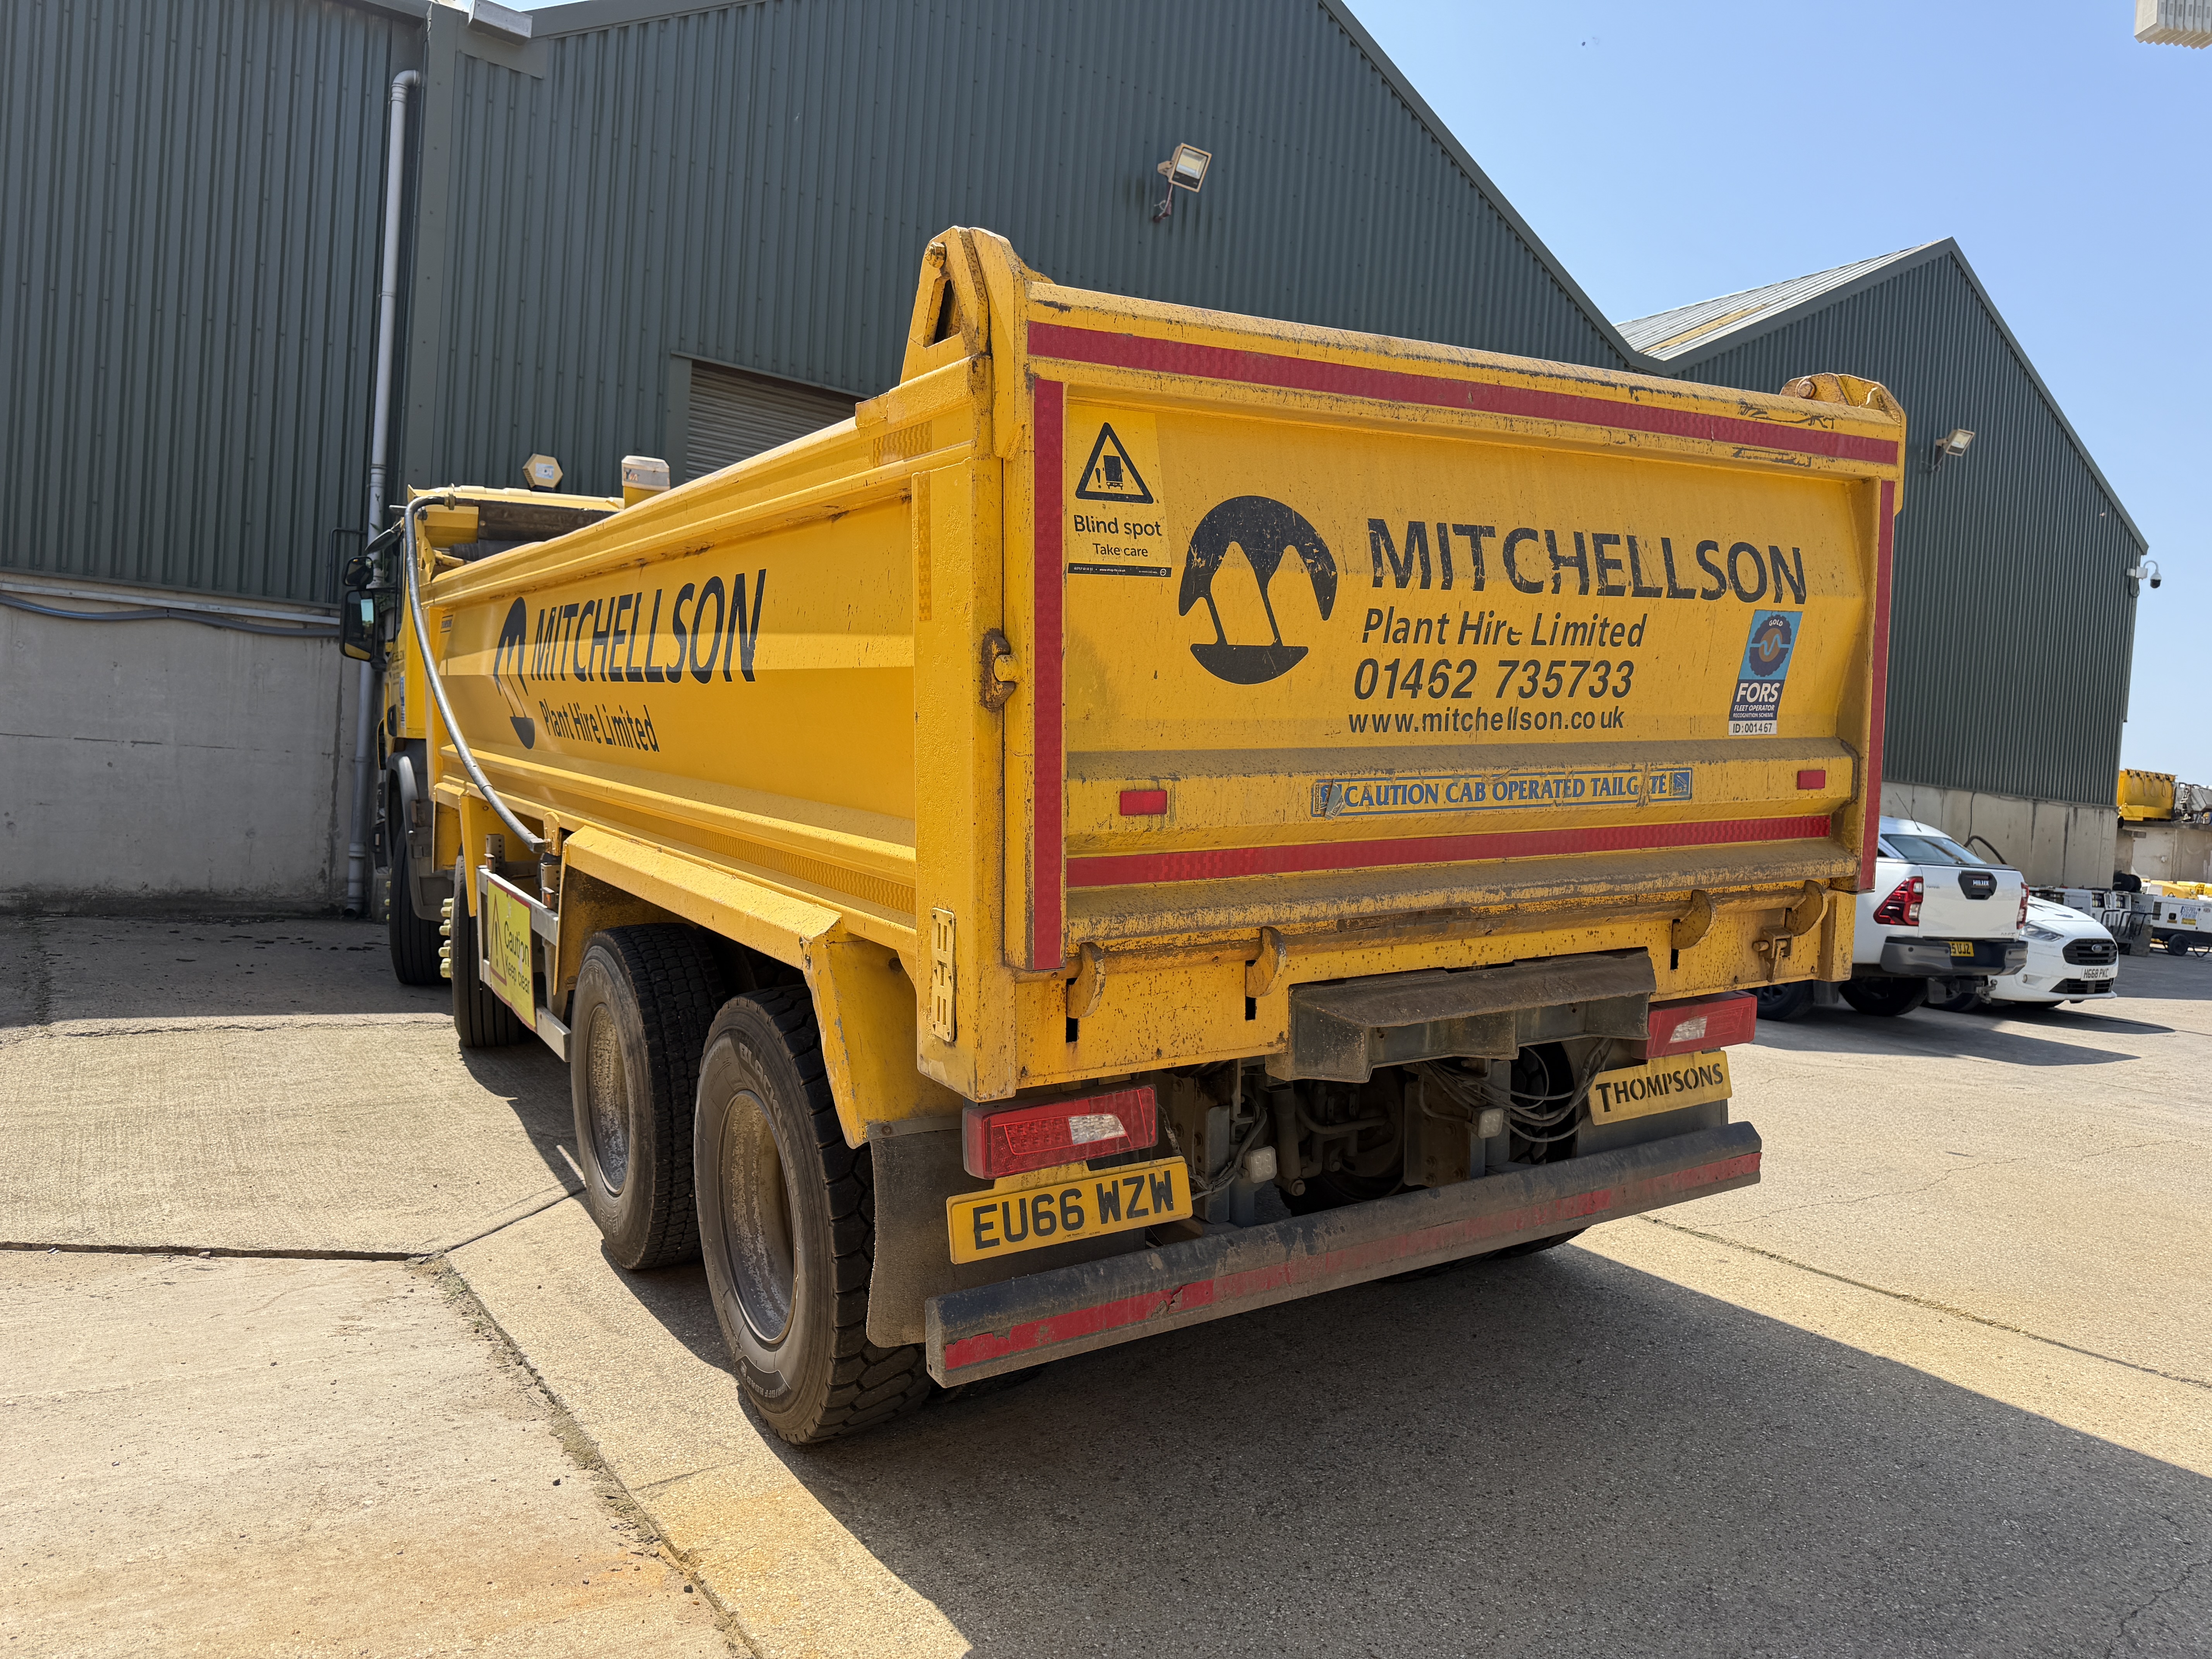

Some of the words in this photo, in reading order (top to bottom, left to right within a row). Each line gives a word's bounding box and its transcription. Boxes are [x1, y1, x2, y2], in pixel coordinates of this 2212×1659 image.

[1074, 515, 1119, 534] Blind
[1124, 521, 1163, 539] spot
[1092, 543, 1120, 555] Take
[1124, 547, 1148, 556] care
[1367, 518, 1807, 605] MITCHELLSON
[531, 568, 766, 684] MITCHELLSON
[1362, 606, 1449, 644] Plant
[1457, 610, 1523, 646] Hire
[1531, 612, 1648, 647] Limited
[1354, 658, 1476, 699] 01462
[1496, 659, 1635, 698] 735733
[1736, 683, 1780, 702] FORS
[539, 699, 575, 740] Plant
[569, 702, 599, 744] Hire
[595, 704, 660, 752] Limited
[1344, 783, 1438, 807] CAUTION
[1445, 781, 1486, 803] CAB
[1492, 778, 1585, 801] OPERATED
[1590, 775, 1667, 797] TAILGTE
[504, 921, 529, 967] Caution
[505, 954, 517, 986] Keep
[518, 971, 530, 994] clear
[1595, 1063, 1723, 1113] THOMPSONS
[972, 1188, 1084, 1250] EU66
[1096, 1170, 1174, 1225] WZW
